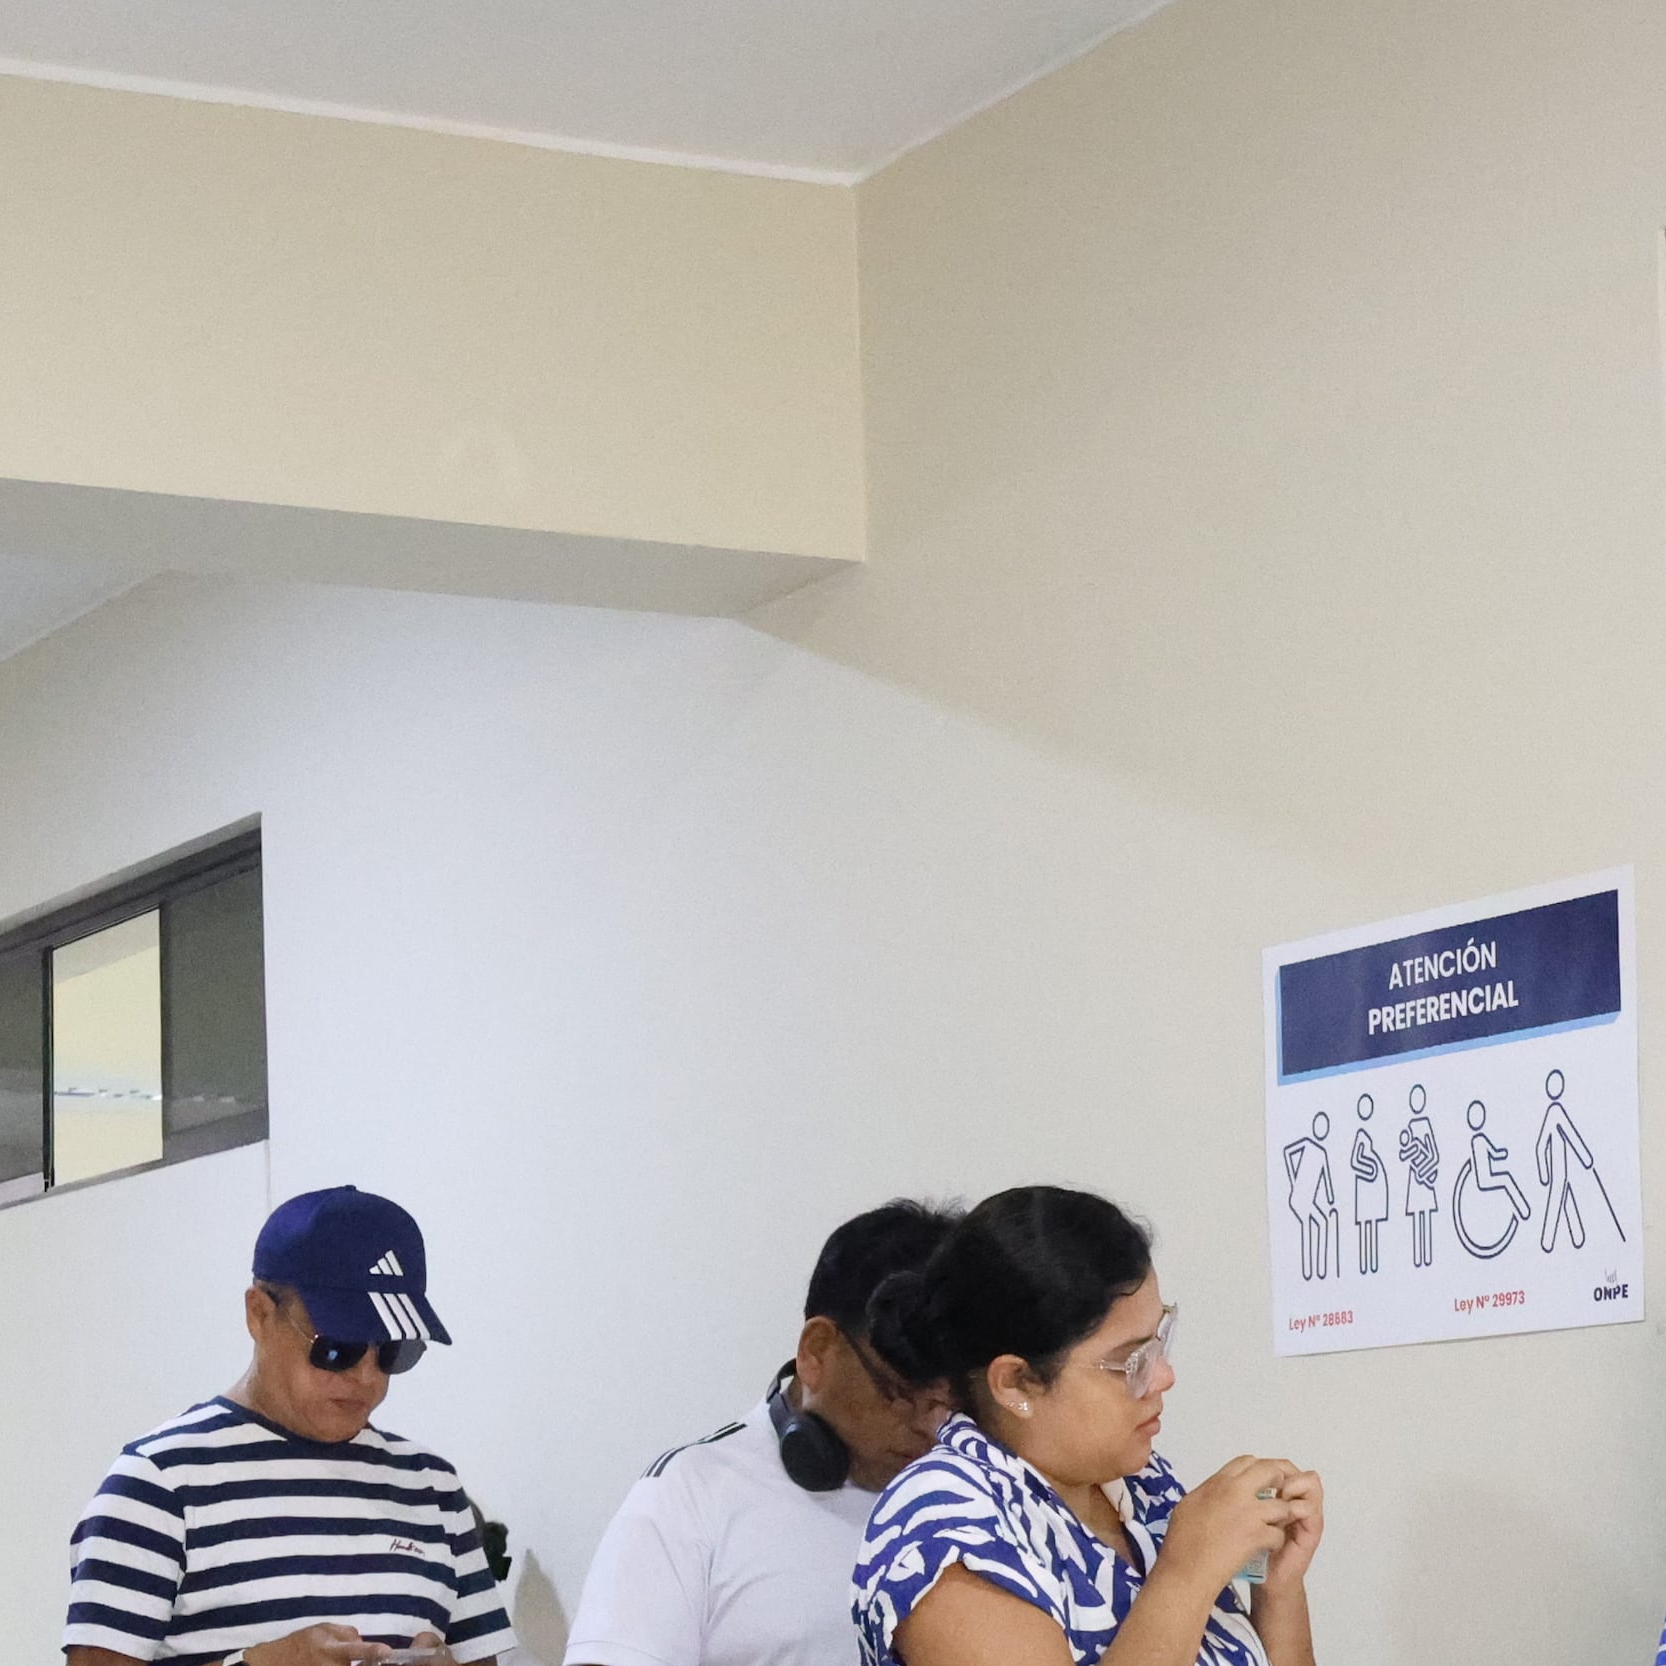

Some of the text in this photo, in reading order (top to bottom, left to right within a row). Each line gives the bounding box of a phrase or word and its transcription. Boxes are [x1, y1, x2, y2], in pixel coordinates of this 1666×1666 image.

[1388, 936, 1497, 990] ATENCIÓN
[1368, 981, 1518, 1036] PREFERENCIAL
[1454, 1298, 1474, 1314] Ley
[1492, 1290, 1526, 1308] 29973
[1594, 1284, 1628, 1302] ONPE
[1289, 1318, 1306, 1334] Ley
[1322, 1310, 1354, 1327] 28683
